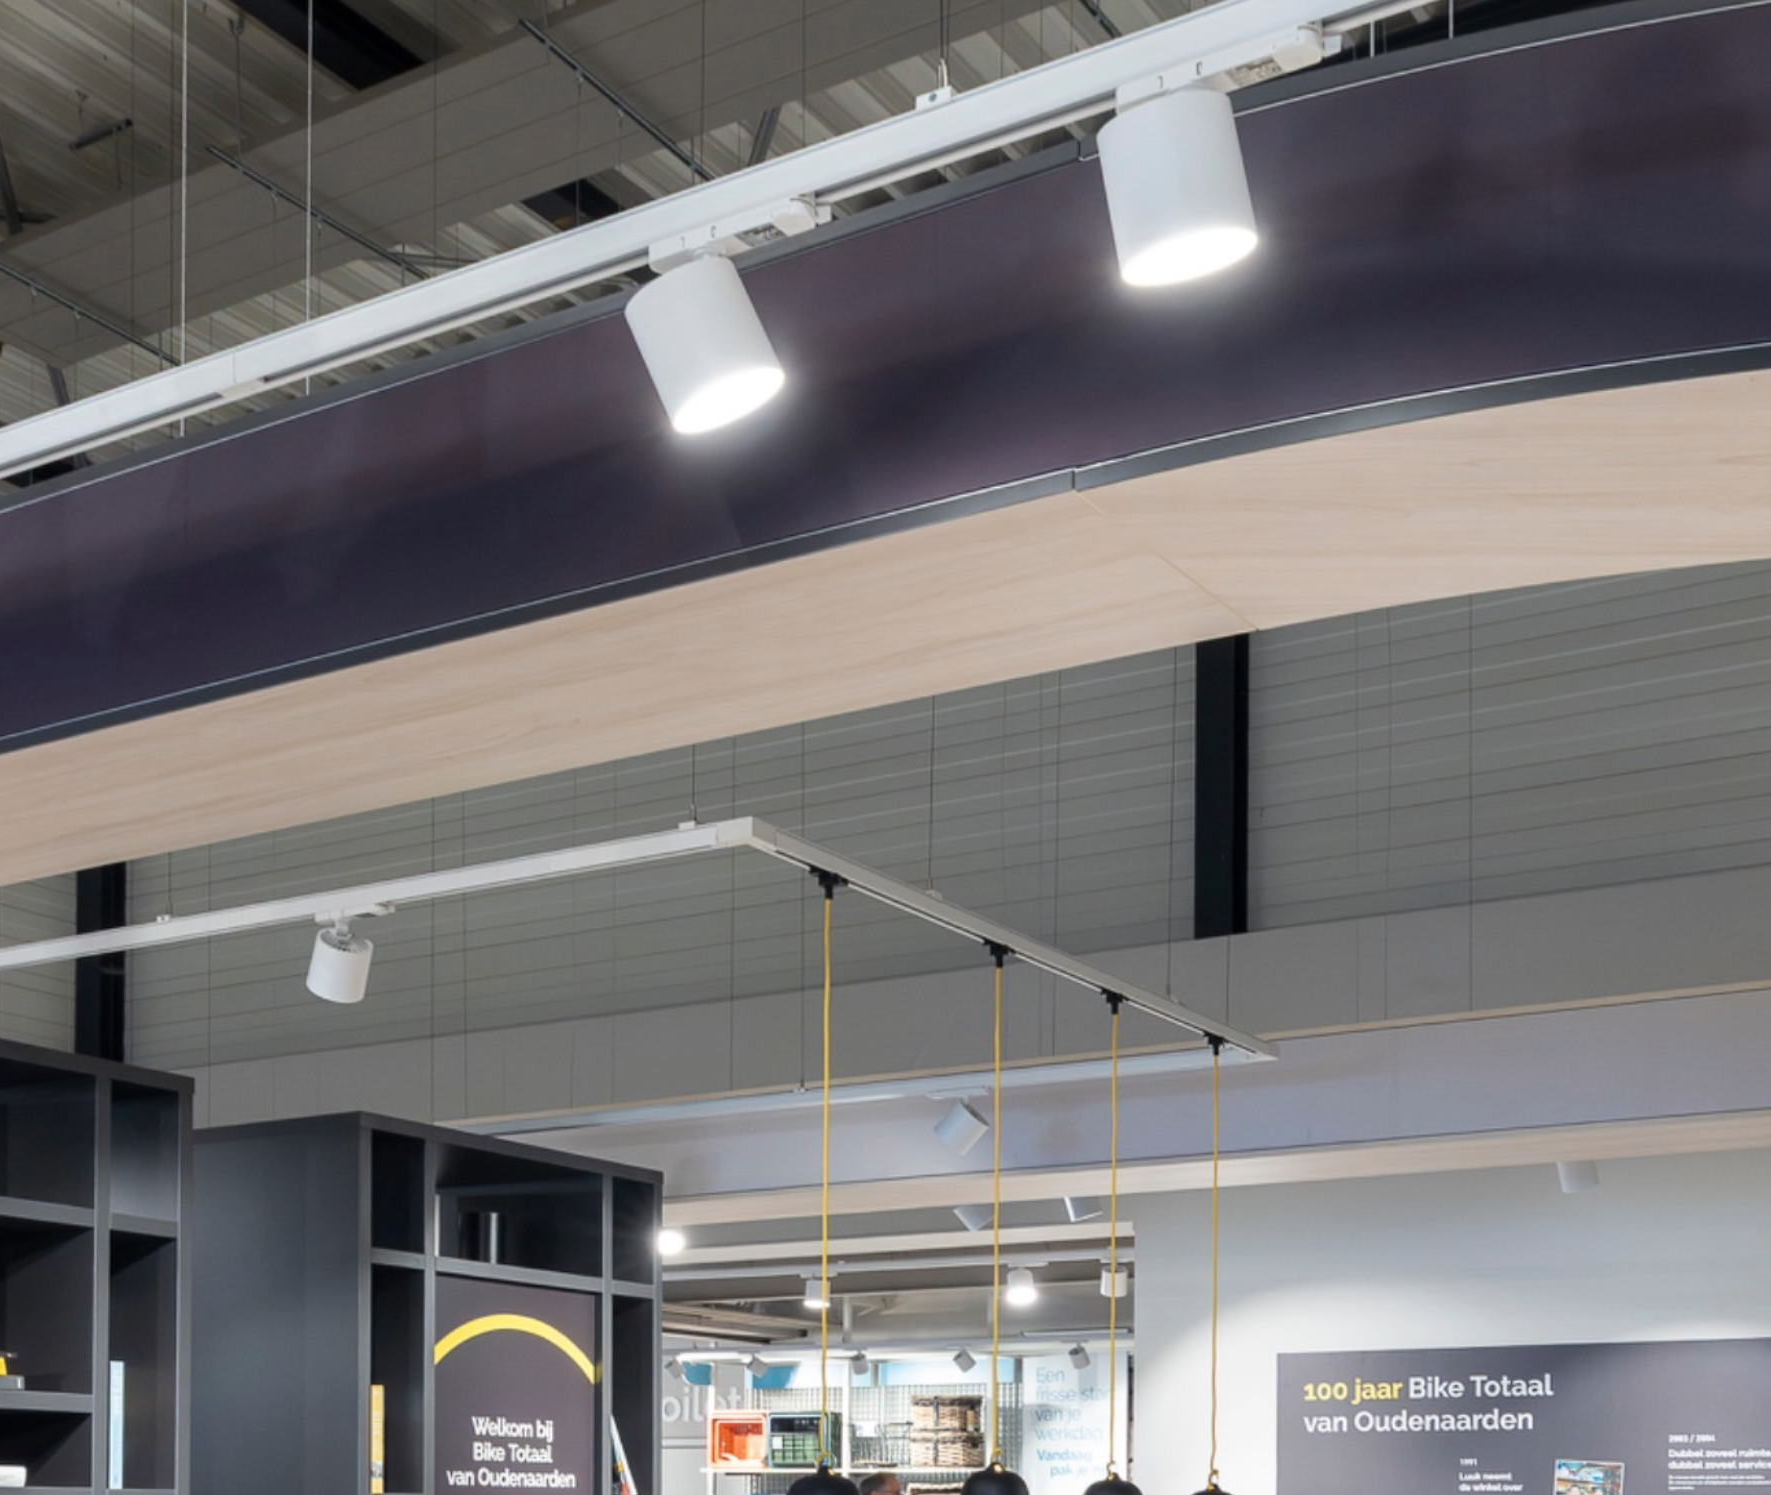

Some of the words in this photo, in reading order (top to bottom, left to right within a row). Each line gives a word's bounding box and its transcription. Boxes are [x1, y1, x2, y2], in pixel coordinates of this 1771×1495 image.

[1303, 1380, 1347, 1401] 100
[1351, 1378, 1403, 1405] jaar
[1409, 1375, 1465, 1399] Bike
[1470, 1373, 1554, 1398] Totaal
[662, 1386, 741, 1422] oilt
[1035, 1408, 1063, 1421] van
[471, 1416, 533, 1438] Welkom
[536, 1419, 553, 1443] bij
[1304, 1413, 1347, 1433] van
[1354, 1409, 1533, 1432] Oudenaarden
[472, 1442, 505, 1462] Bike
[508, 1443, 553, 1464] Totaal
[1668, 1448, 1703, 1458] Dubbel
[1706, 1448, 1737, 1458] zoveel
[1668, 1459, 1703, 1469] dubbel
[1705, 1460, 1737, 1469] zoveel
[446, 1469, 475, 1486] van
[477, 1467, 576, 1489] Oudenaarden
[1458, 1483, 1471, 1492] de
[1502, 1484, 1523, 1492] over
